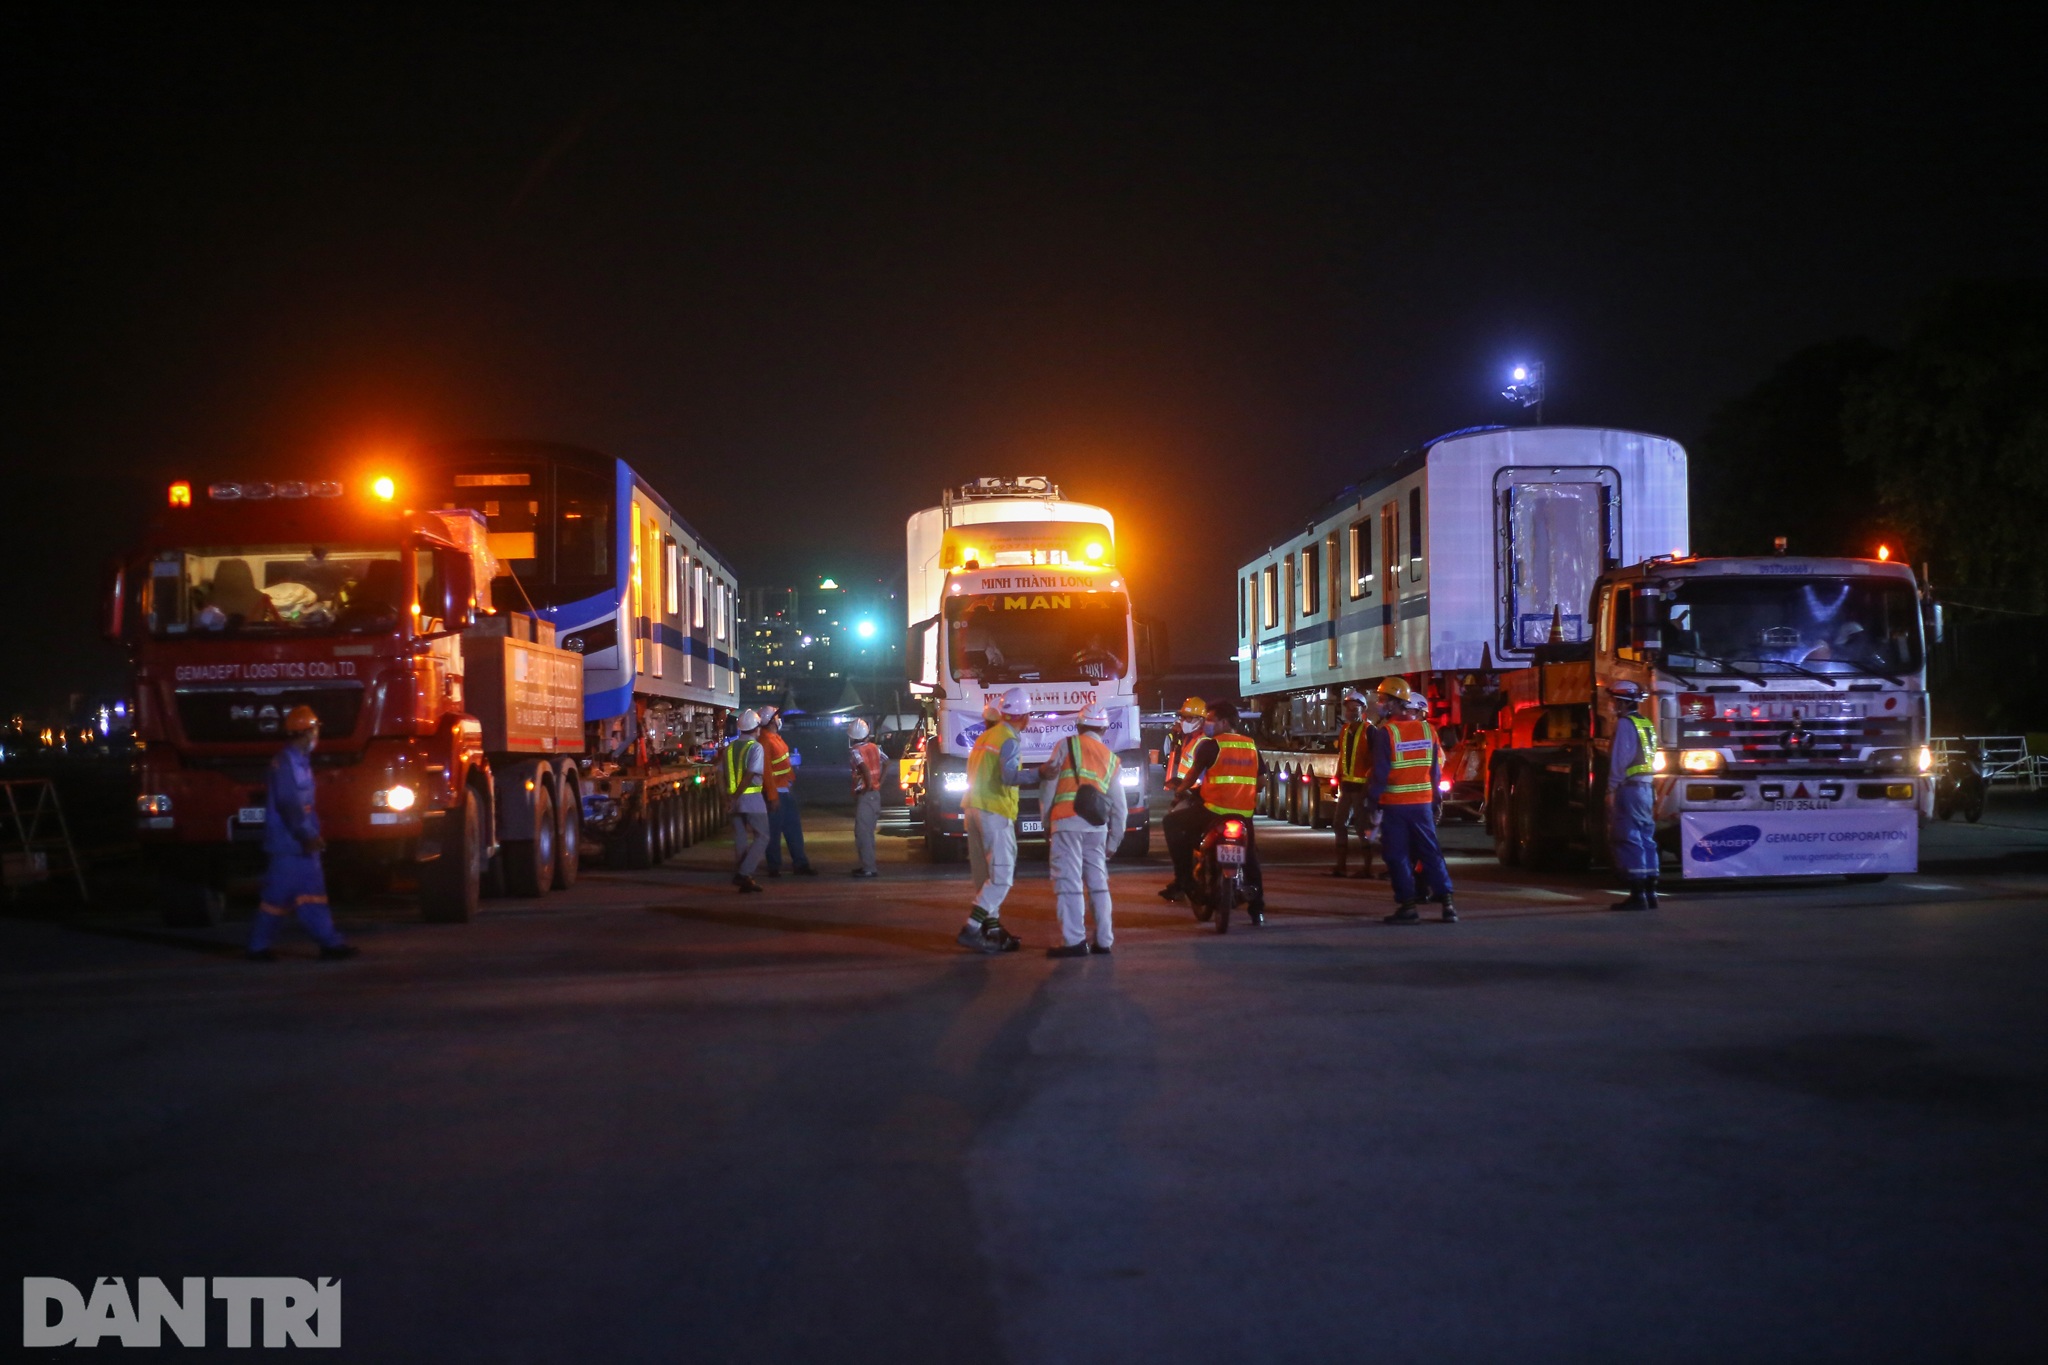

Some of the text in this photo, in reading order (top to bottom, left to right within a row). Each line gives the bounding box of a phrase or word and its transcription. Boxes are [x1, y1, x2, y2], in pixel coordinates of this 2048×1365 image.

[981, 574, 1093, 590] MINH THÀNH LONG
[1004, 595, 1071, 610] MAN
[175, 664, 241, 681] GEMADEPT
[243, 663, 305, 679] LOGISTICS
[1064, 691, 1097, 705] LONG
[1697, 838, 1755, 849] GEMADEPT
[1764, 830, 1908, 844] GEMADEPT CORPORATION
